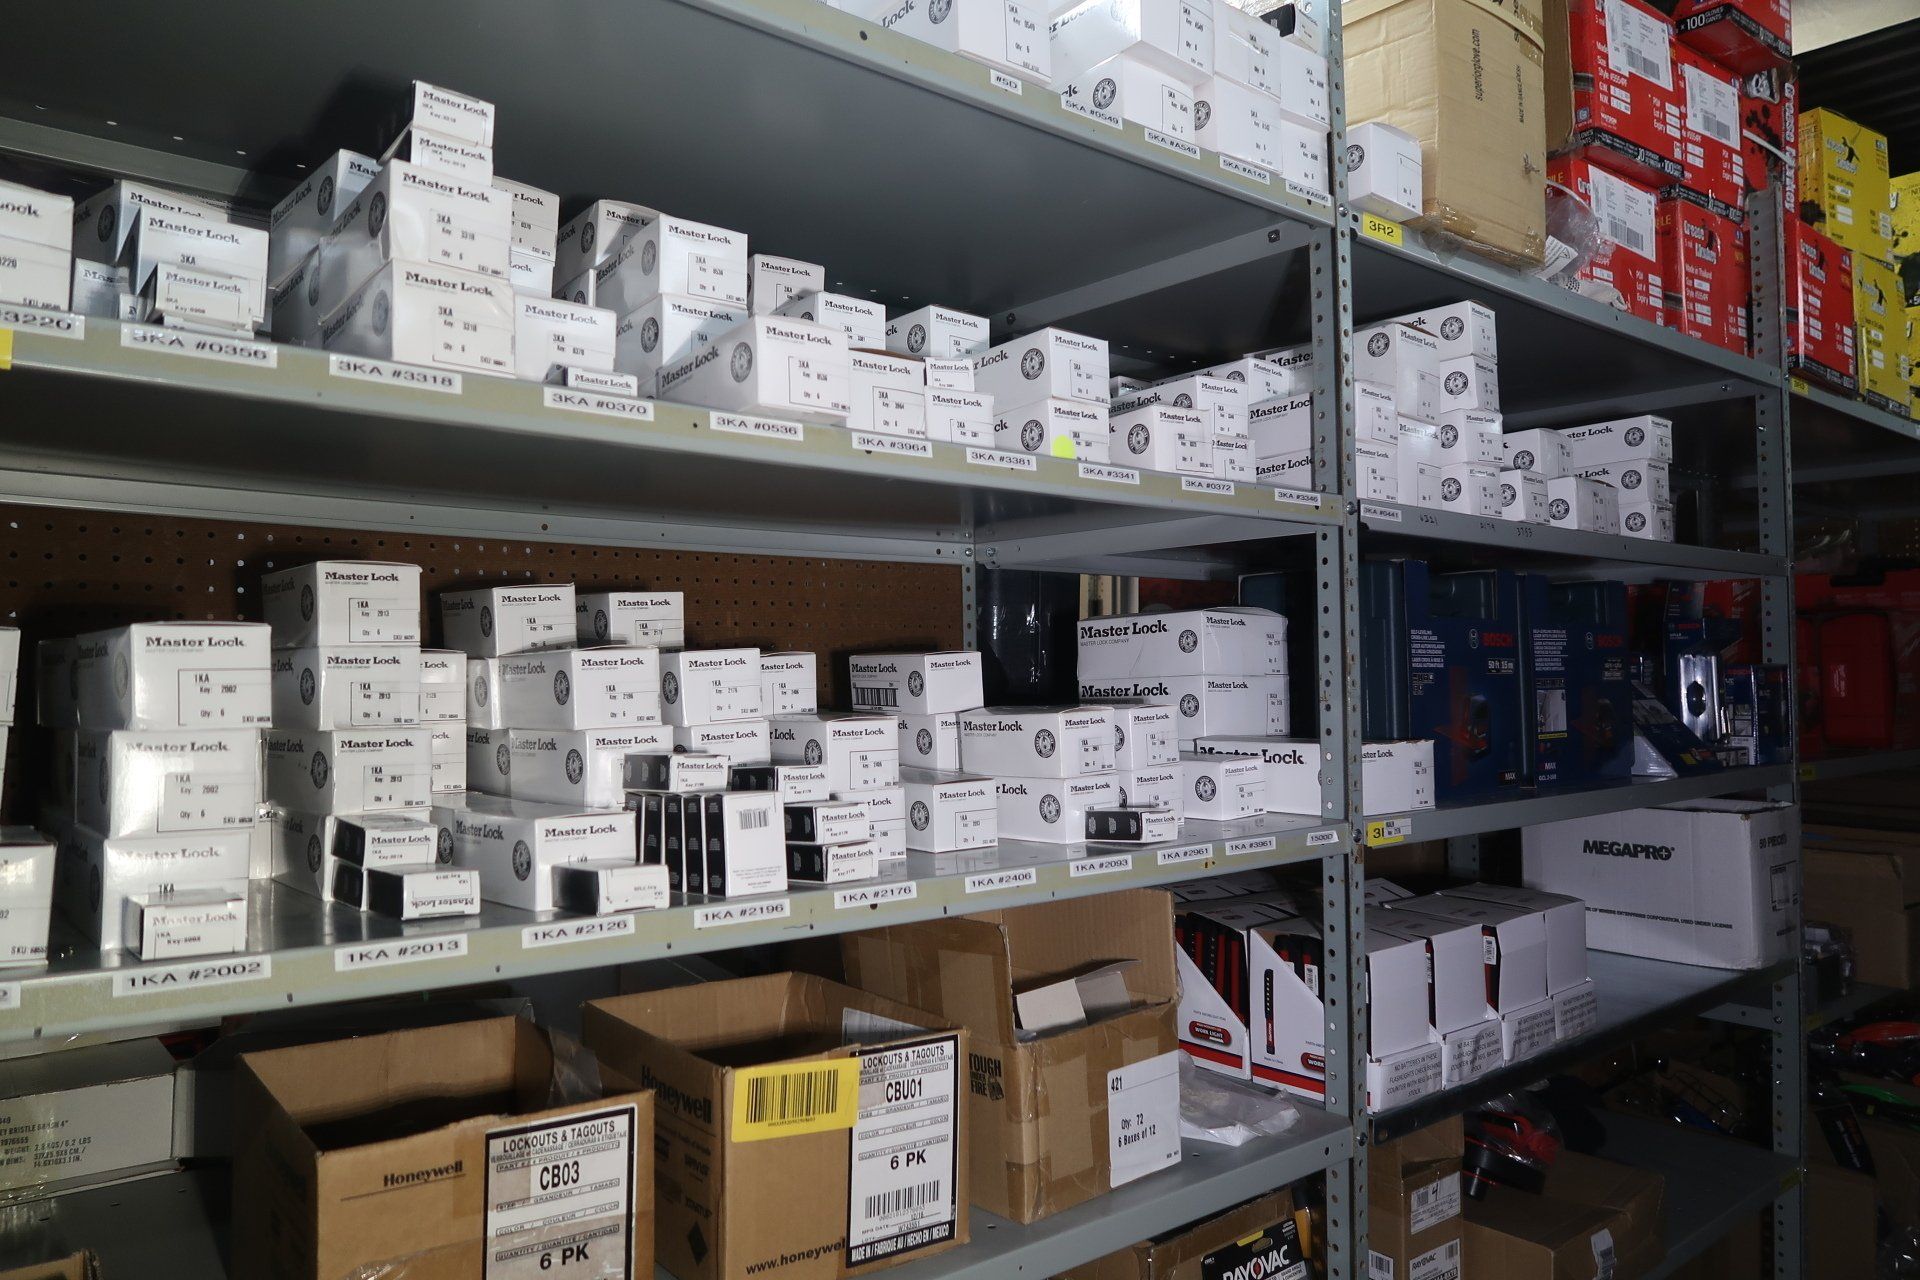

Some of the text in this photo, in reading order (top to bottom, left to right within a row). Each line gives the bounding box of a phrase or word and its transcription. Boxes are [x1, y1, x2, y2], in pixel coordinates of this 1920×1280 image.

[1687, 14, 1705, 30] 100
[1065, 100, 1118, 125] 5KA #0549
[1147, 131, 1197, 155] 5KA #A549
[1223, 159, 1267, 180] 5KA #A142
[403, 172, 490, 204] Master Lock
[1288, 183, 1305, 194] 5KA
[149, 216, 240, 245] Master Lock
[668, 224, 732, 245] Master Lock
[1369, 220, 1394, 238] 3R2
[180, 253, 196, 265] 3KA
[525, 303, 599, 326] Master Lock
[132, 327, 185, 348] 3KA
[766, 325, 832, 345] Master Lock
[338, 360, 453, 388] 3KA #3318
[852, 358, 911, 375] Master Lock
[552, 392, 647, 414] 3KA #0370
[1159, 411, 1201, 423] Master Lock
[716, 416, 798, 436] 3KA #0536
[858, 436, 927, 453] 3KA #3964
[971, 451, 1031, 467] 3KA #3381
[1082, 467, 1135, 480] 3KA #3341
[1185, 480, 1231, 492] 3KA #0372
[1278, 492, 1294, 500] 3KA
[325, 572, 399, 582] Master Lock
[501, 594, 561, 603] Master Lock
[1080, 620, 1168, 640] Master Lock
[145, 636, 244, 648] Master Lock
[1482, 633, 1513, 647] BOSCH
[327, 656, 400, 665] Master Lock
[581, 657, 644, 667] Master Lock
[689, 658, 747, 668] Master Lock
[1082, 683, 1169, 698] Master Lock
[701, 730, 758, 742] Master Lock
[832, 728, 885, 737] Master Lock
[340, 738, 414, 749] Master Lock
[595, 736, 658, 746] Master Lock
[1262, 749, 1305, 765] Lock
[1377, 750, 1393, 758] Lock
[676, 762, 724, 770] Master Lock
[1545, 762, 1556, 770] MAX
[1505, 772, 1516, 780] MAX
[939, 791, 967, 799] Master
[1001, 784, 1028, 796] Lock
[544, 824, 617, 838] Master Lock
[371, 835, 431, 845] Master Lock
[1230, 840, 1272, 851] 1KA #3961
[1162, 848, 1209, 860] 1KA #2961
[1583, 839, 1672, 861] MEGAPRO
[1075, 859, 1129, 871] 1KA #2093
[971, 872, 1032, 888] 1KA #2406
[158, 883, 175, 895] 1KA
[842, 886, 912, 903] 1KA #2176
[702, 903, 784, 921] 1KA #2196
[532, 919, 628, 942] 1KA #2126
[348, 940, 460, 963] 1KA #2013
[128, 961, 261, 988] 1KA #2002
[1195, 1027, 1223, 1039] WORK LIGHT
[863, 1052, 902, 1069] LOCKOUTS
[905, 1051, 909, 1061] &
[912, 1045, 944, 1059] TAGOUTS
[968, 1053, 1002, 1078] TOUGH
[886, 1077, 922, 1103] CBU01
[970, 1080, 987, 1096] FIRE
[1111, 1076, 1123, 1092] 421
[641, 1066, 712, 1125] Honeywell
[1121, 1113, 1144, 1130] Qty: 72
[503, 1132, 558, 1153] LOCKOUTS
[562, 1130, 567, 1142] &
[571, 1120, 615, 1140] TAGOUTS
[1118, 1124, 1156, 1148] 6 Boxes of 12
[890, 1149, 926, 1170] 6 PK
[383, 1160, 464, 1188] Honeywell
[539, 1160, 580, 1190] CB03
[852, 1246, 865, 1260] MADE
[865, 1246, 871, 1257] IN
[923, 1230, 929, 1241] EN
[540, 1243, 589, 1270] 6 PK
